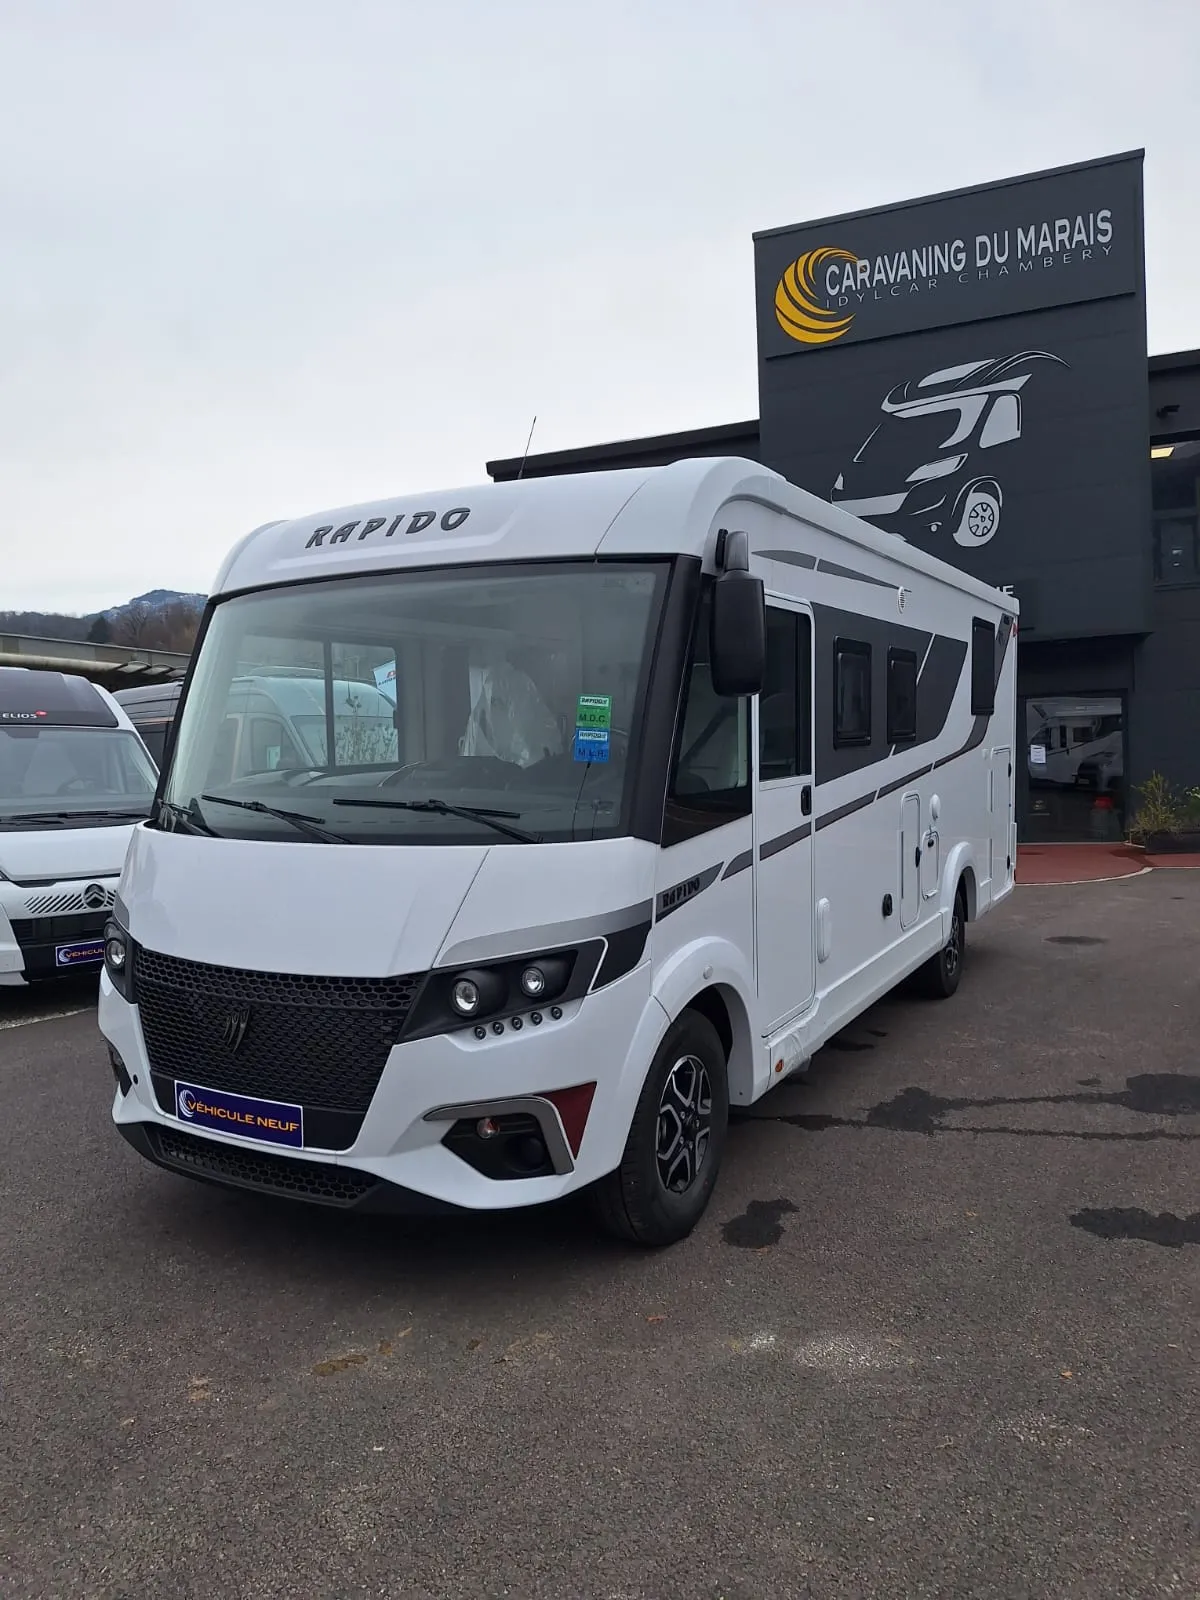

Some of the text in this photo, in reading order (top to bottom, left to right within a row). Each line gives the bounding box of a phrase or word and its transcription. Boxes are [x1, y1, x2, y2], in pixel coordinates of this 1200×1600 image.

[825, 209, 1114, 297] CARAVANING DU MARAIS
[825, 244, 1113, 309] IDYLCAR CHAMBERY
[304, 507, 472, 549] RAPIDO
[662, 876, 701, 909] RAPIDO
[187, 1099, 300, 1132] VÉHICULE NEUF
